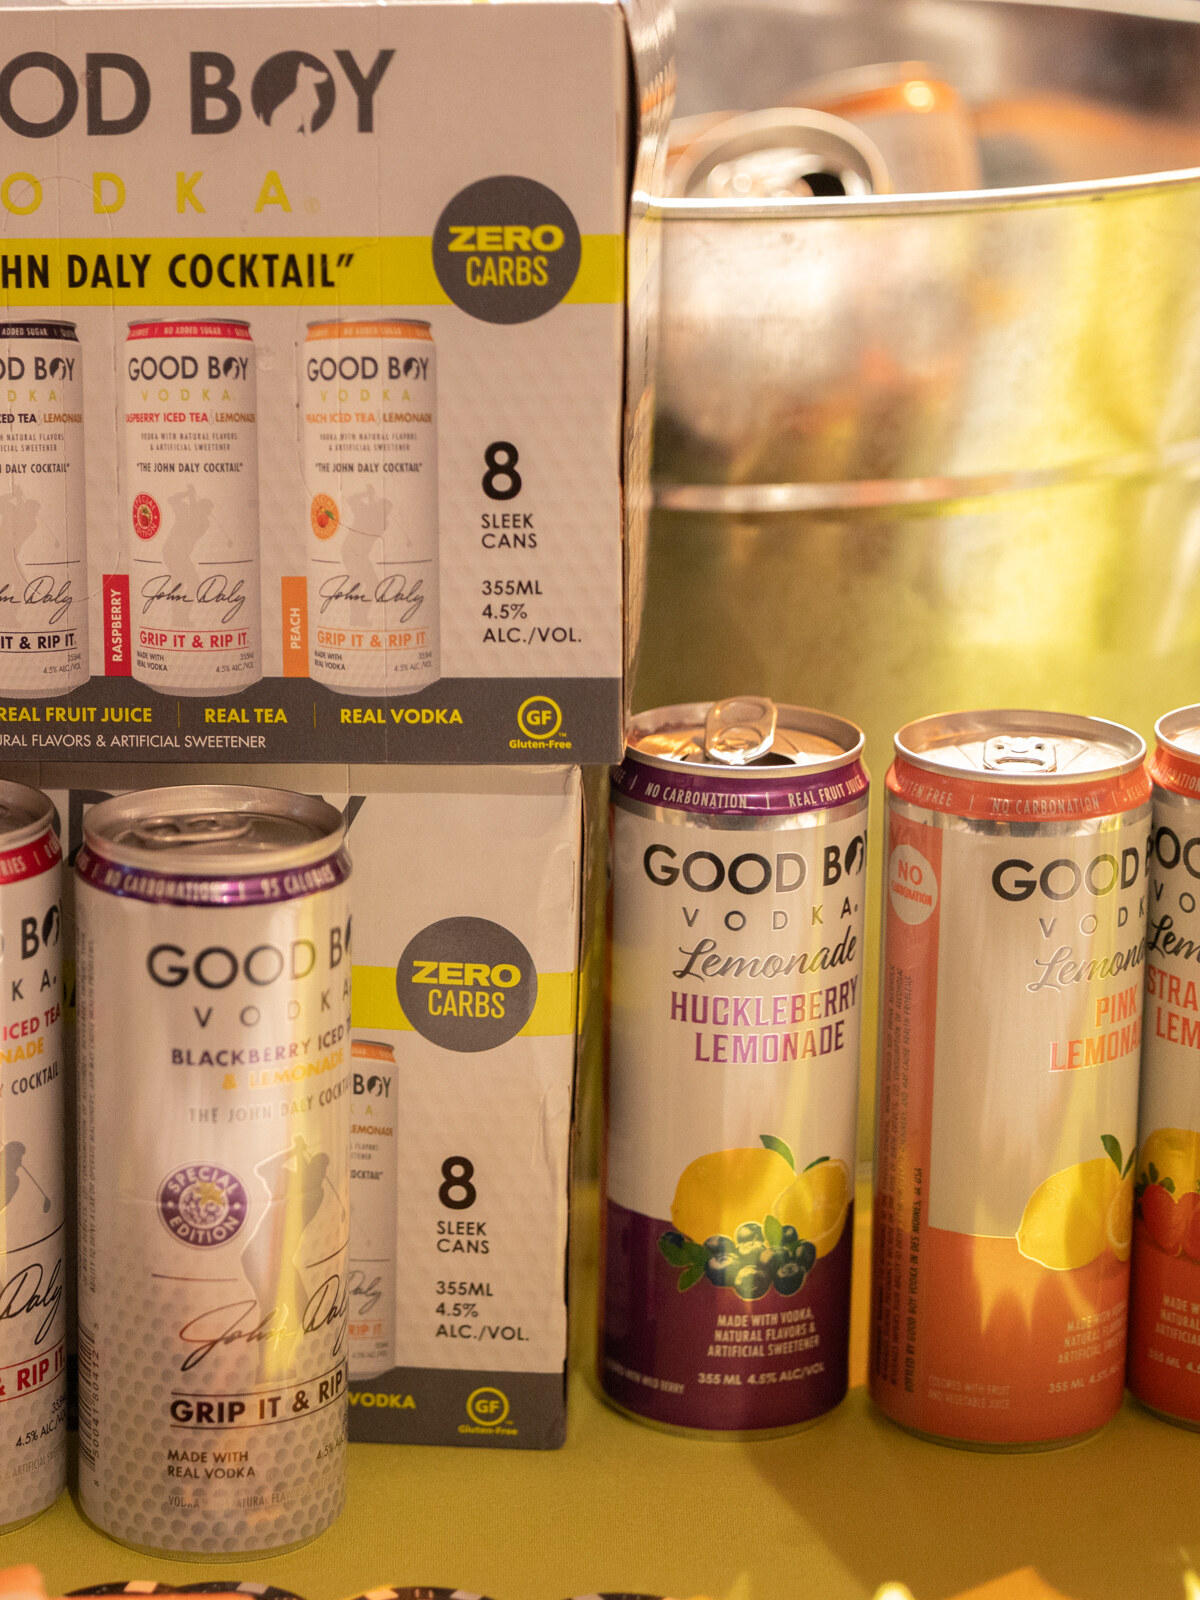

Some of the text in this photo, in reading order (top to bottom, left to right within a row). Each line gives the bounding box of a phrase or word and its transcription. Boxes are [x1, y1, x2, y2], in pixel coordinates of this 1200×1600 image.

[189, 49, 396, 136] BOY
[447, 224, 565, 253] ZERO
[67, 253, 152, 289] DALY
[466, 255, 549, 287] CARBS
[35, 357, 75, 382] BOY
[128, 356, 249, 381] GOOD BOY
[307, 356, 428, 382] GOOD BOY
[17, 413, 37, 424] TEA
[163, 412, 208, 423] ICED TEA
[482, 440, 522, 500] 8
[481, 513, 534, 529] SLEEK
[481, 533, 537, 549] CANS
[481, 580, 543, 596] 355ML
[481, 603, 528, 620] 4.5%
[112, 588, 123, 662] RASPBERRY
[290, 607, 300, 650] PEACH
[482, 627, 582, 645] ALC./VOL.
[38, 635, 60, 649] RIP
[46, 707, 97, 722] FRUIT
[101, 707, 152, 723] JUICE
[205, 708, 288, 723] REAL TEA
[340, 709, 463, 724] REAL VODKA
[32, 734, 91, 747] FLAVORS
[96, 735, 106, 747] &
[110, 735, 180, 747] ARTIFICIAL
[184, 735, 266, 748] SWEETENER
[509, 739, 572, 749] Gluten-Free
[644, 782, 748, 809] NO CARBONATION
[788, 783, 846, 808] REAL FRUIT
[992, 795, 1100, 816] NO CARBONATION
[643, 843, 808, 895] GOOD
[898, 859, 923, 885] NO
[992, 847, 1139, 902] GOOD
[146, 938, 317, 990] GOOD
[672, 924, 857, 982] Lemonade
[412, 960, 522, 988] ZERO
[428, 988, 506, 1019] CARBS
[670, 974, 858, 1027] HUCKLEBERRY
[1095, 983, 1138, 1029] PINK
[2, 1017, 40, 1041] ICED
[171, 1024, 345, 1067] BLACKBERRY ICED
[694, 1019, 845, 1065] LEMONADE
[11, 1061, 59, 1096] COCKTAIL
[166, 1164, 239, 1195] SPECIAL
[438, 1155, 477, 1210] 8
[167, 1213, 240, 1244] EDITION
[436, 1221, 487, 1236] SLEEK
[436, 1239, 490, 1254] CANS
[436, 1280, 493, 1297] 355ML
[435, 1302, 479, 1318] 4.5%
[717, 1312, 778, 1327] MADE WITH
[435, 1324, 530, 1341] ALC./VOL.
[714, 1328, 762, 1343] NATURAL
[707, 1334, 820, 1358] ARTIFICIAL SWEETENER
[170, 1398, 246, 1424] GRIP
